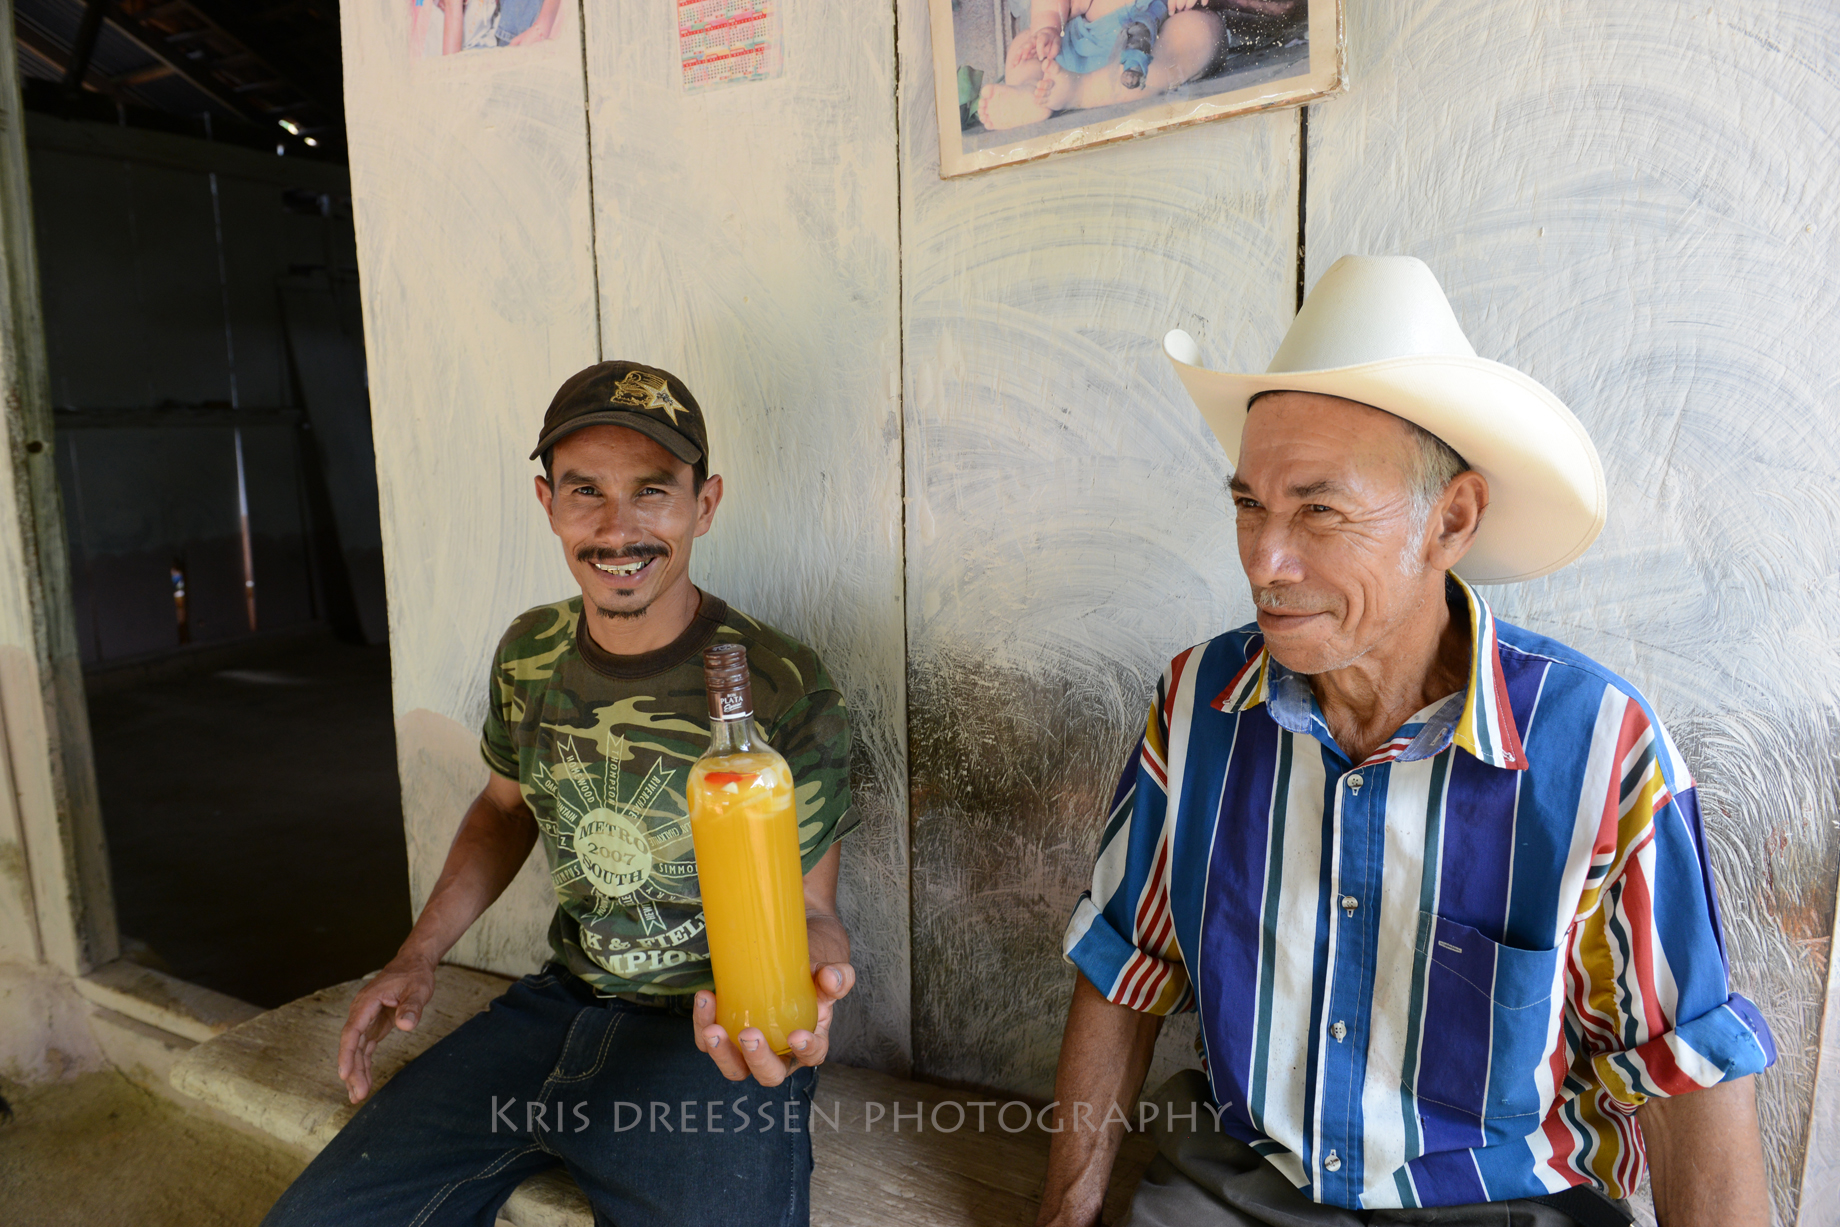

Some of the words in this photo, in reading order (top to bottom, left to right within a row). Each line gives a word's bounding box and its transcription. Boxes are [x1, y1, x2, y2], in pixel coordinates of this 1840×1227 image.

[720, 696, 743, 704] PLATA
[544, 780, 558, 793] OAK
[566, 755, 595, 803] HOMEWOOD
[608, 750, 619, 806] THOMPSON
[628, 775, 661, 819] RIVERCHASE
[579, 820, 648, 855] METRO
[587, 842, 636, 866] 2007
[582, 853, 645, 886] SOUTH
[659, 863, 698, 875] SIMMO
[608, 937, 631, 951] &
